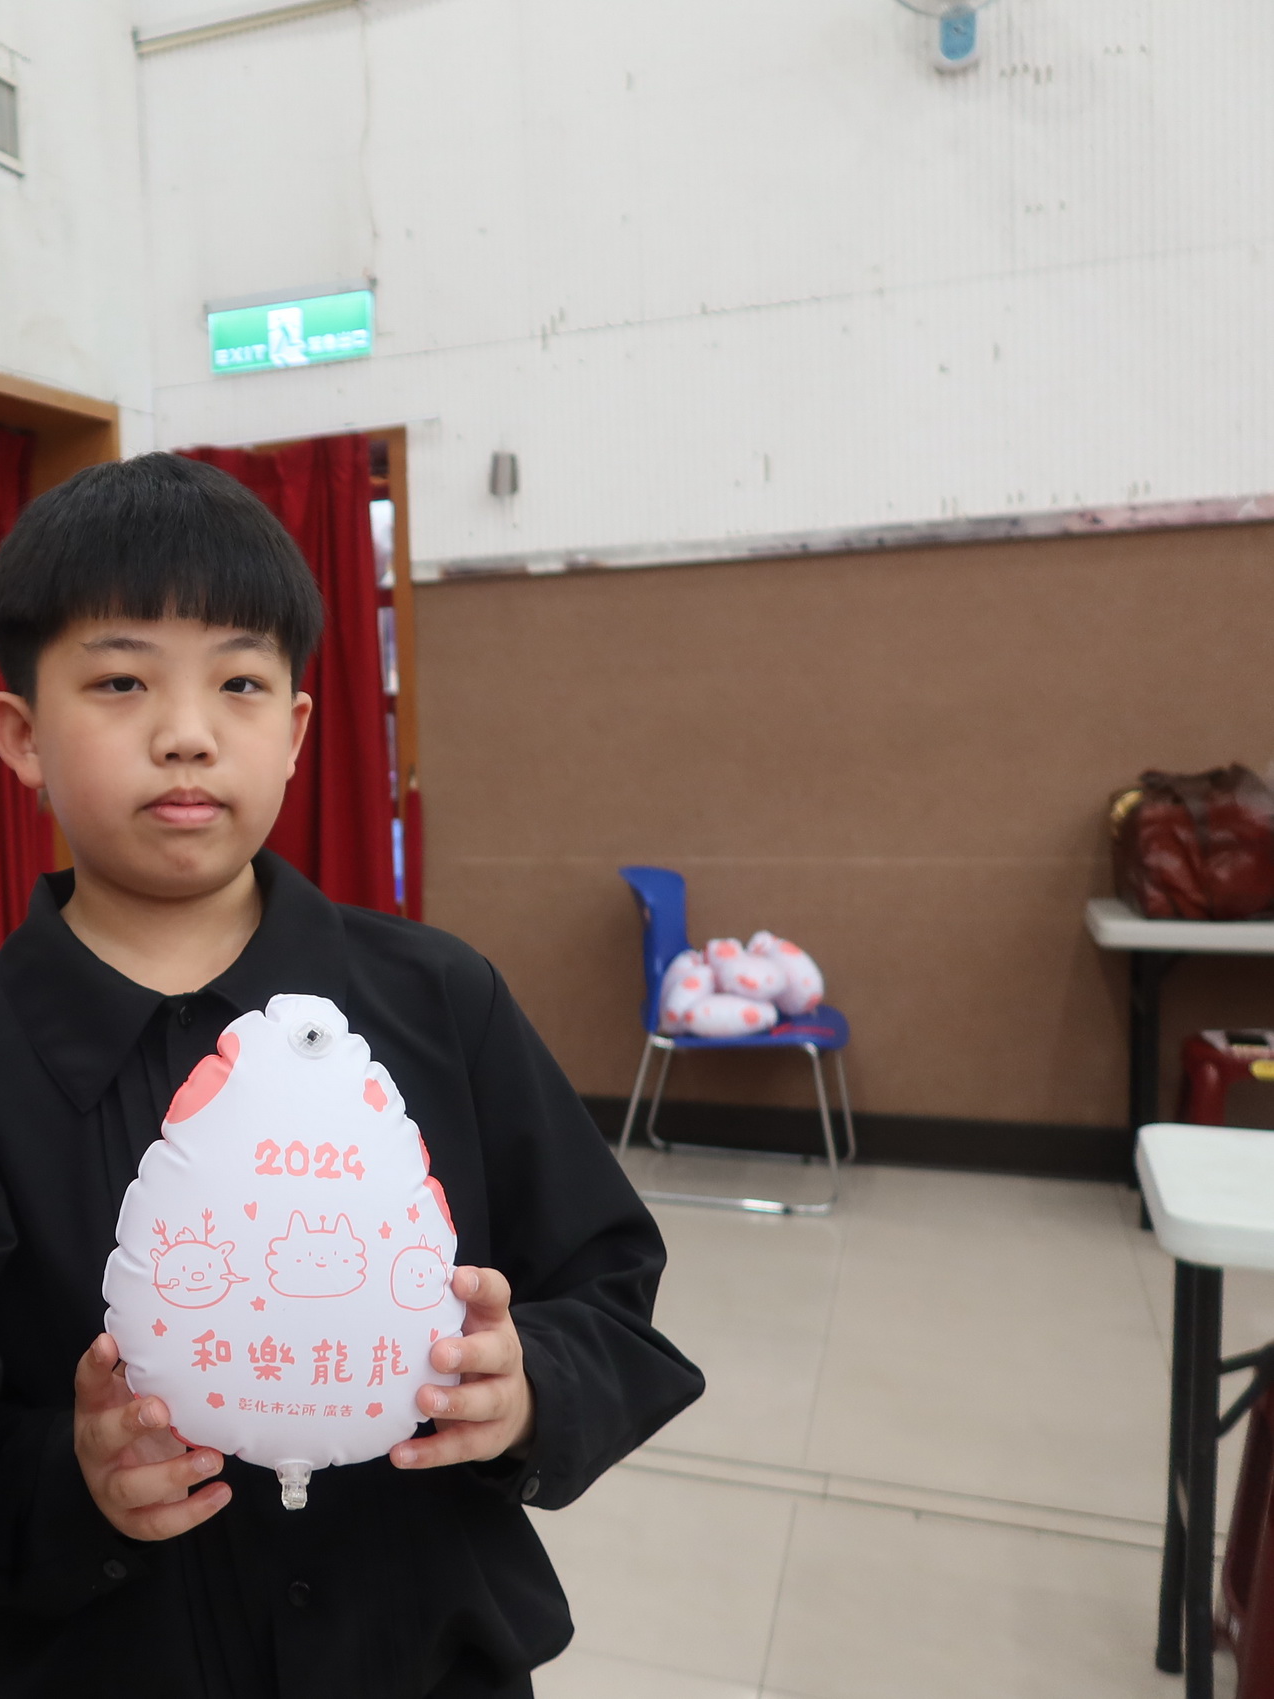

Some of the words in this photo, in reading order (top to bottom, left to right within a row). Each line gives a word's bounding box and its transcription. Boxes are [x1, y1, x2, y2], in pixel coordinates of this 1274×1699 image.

[215, 344, 266, 366] EXIT
[254, 1138, 366, 1181] 2024
[191, 1329, 409, 1388] 和樂龍龍
[238, 1397, 317, 1417] 彰化市公所
[323, 1404, 354, 1418] 廣告
